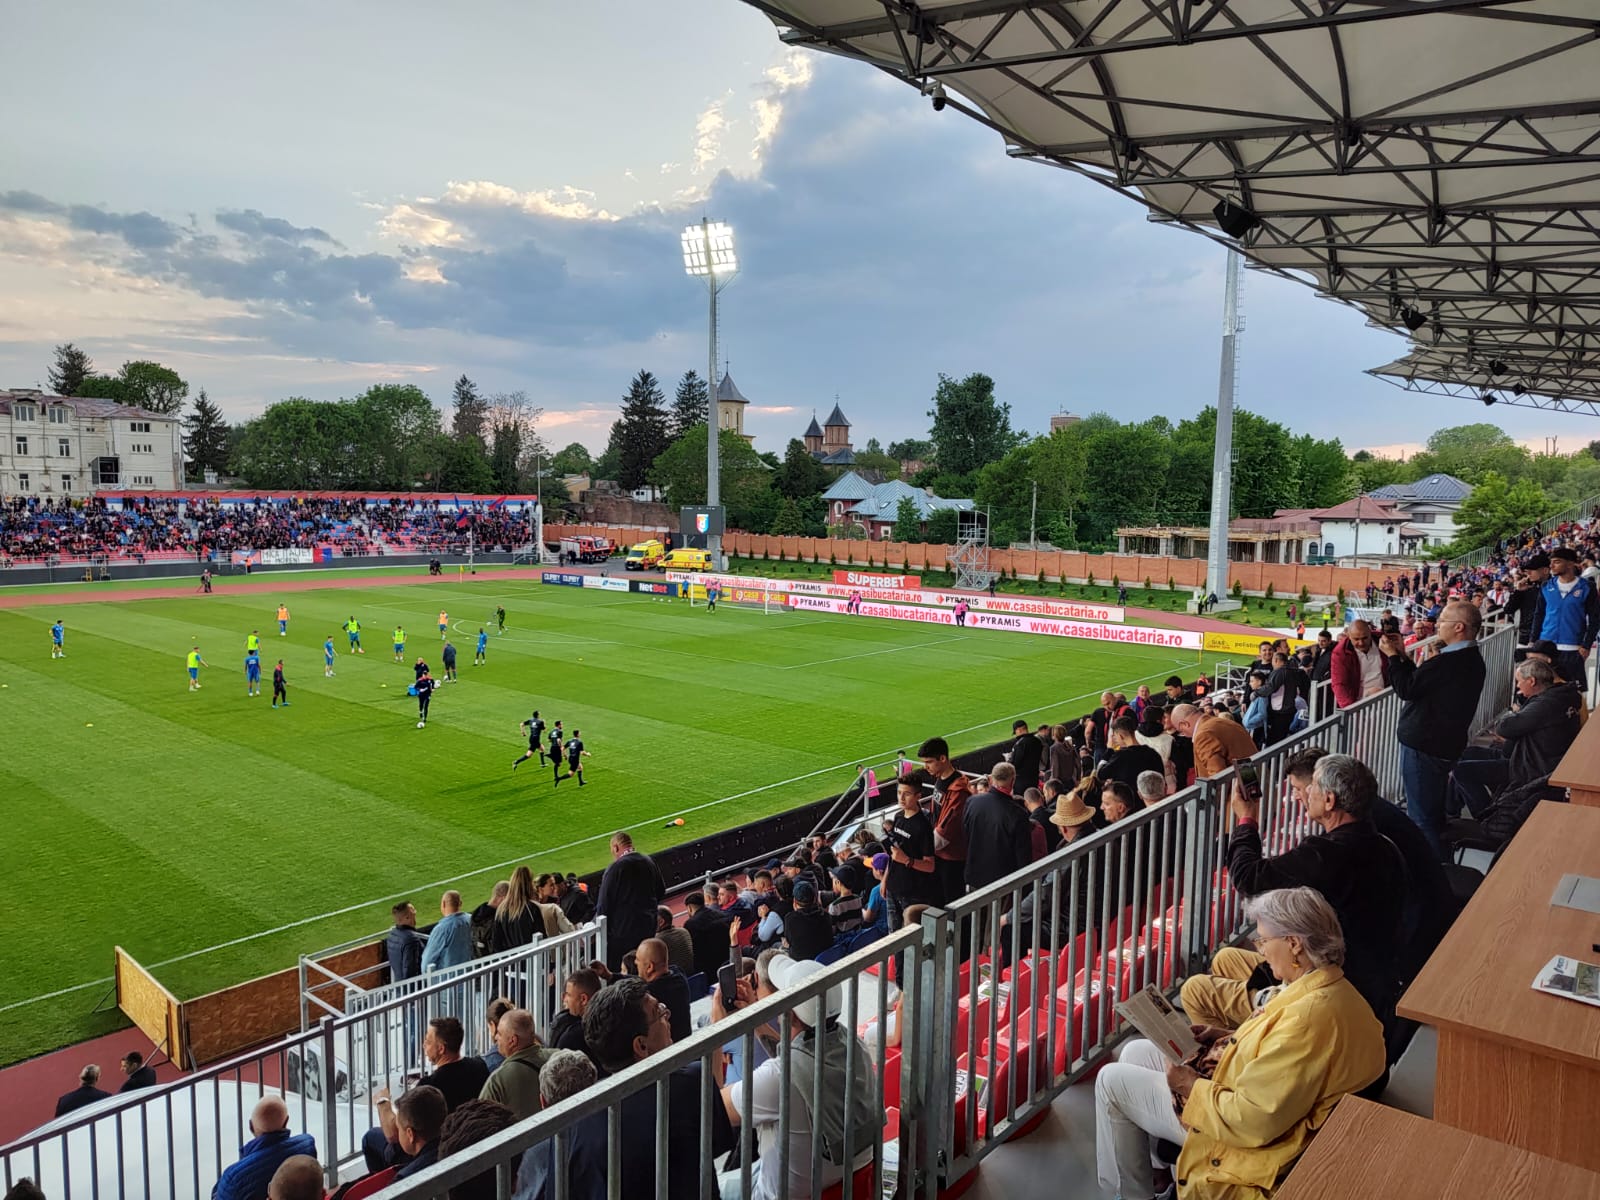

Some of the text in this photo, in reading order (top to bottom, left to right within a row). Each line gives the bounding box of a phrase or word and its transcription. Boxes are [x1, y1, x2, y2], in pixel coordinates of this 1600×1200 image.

[638, 582, 668, 593] NetBet
[847, 572, 906, 588] SUPERBET
[795, 583, 822, 592] PYRAMIS
[826, 587, 923, 603] www.casibucataria.ro
[986, 600, 1109, 620] www.casasibucataria.ro
[800, 598, 831, 608] PYRAMIS
[980, 615, 1021, 628] PYRAMIS
[1030, 621, 1183, 646] www.casasibucataria.ro
